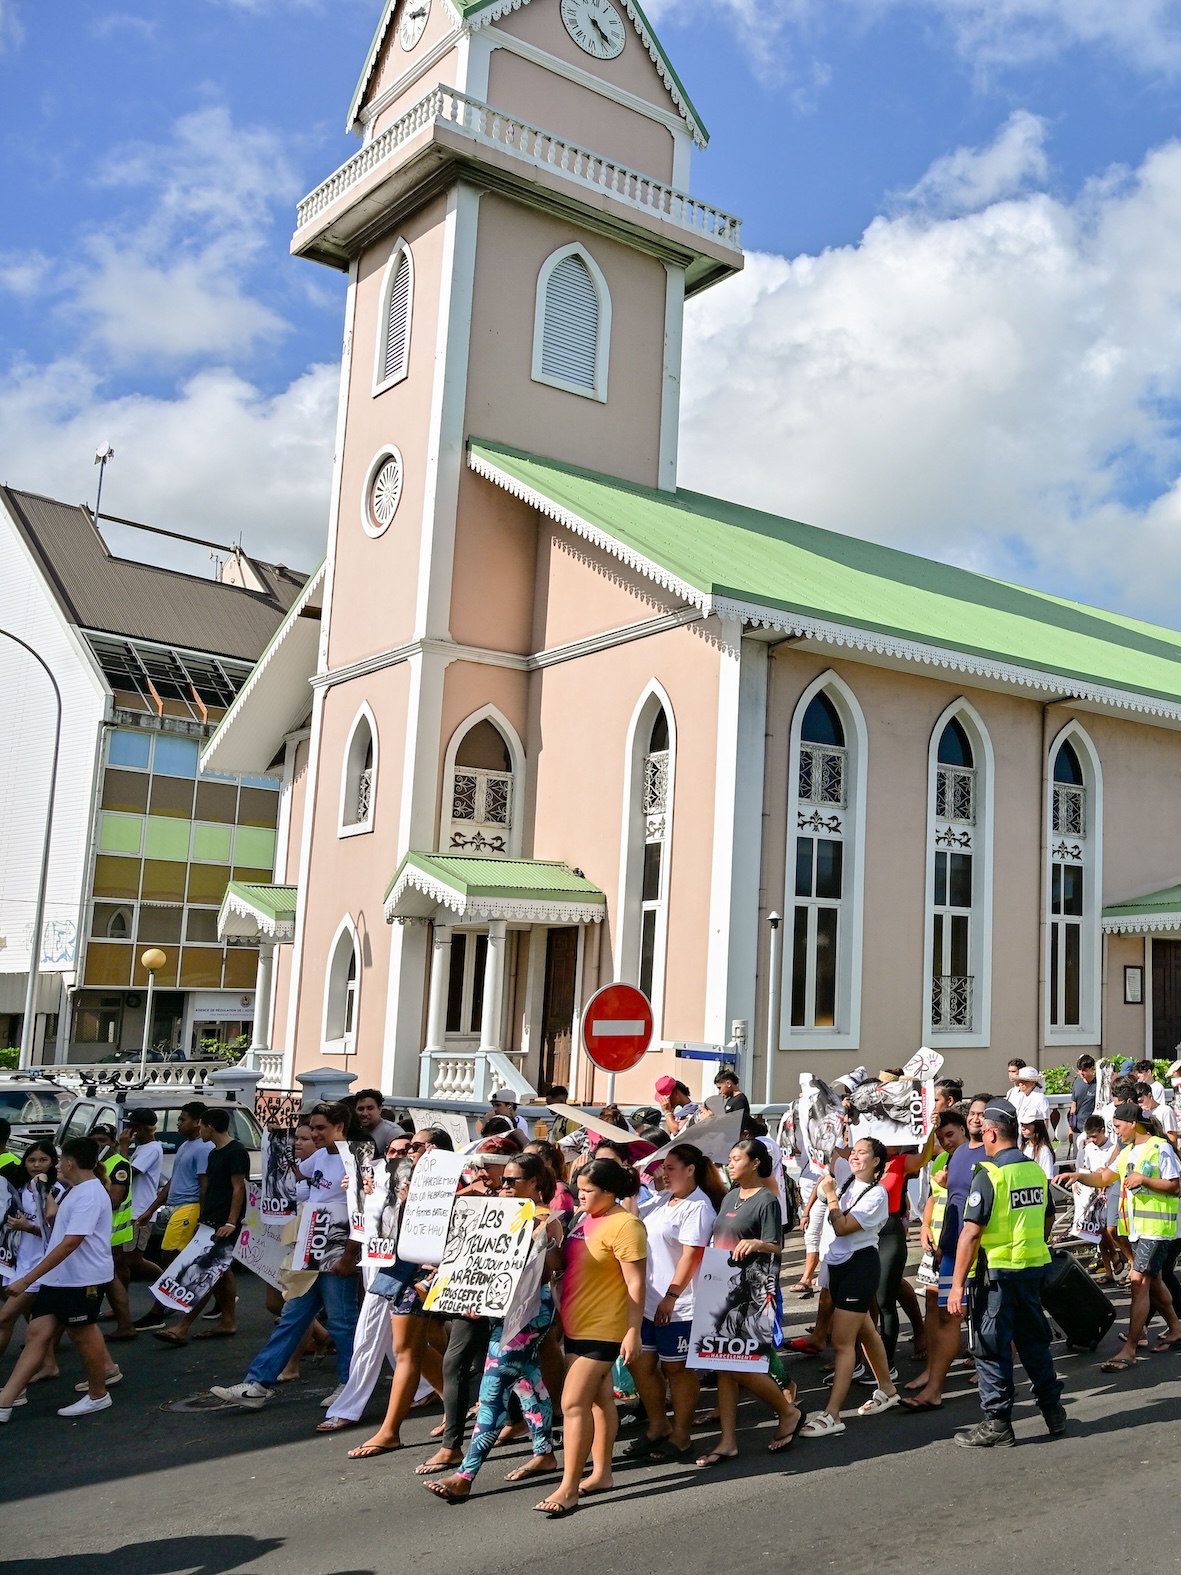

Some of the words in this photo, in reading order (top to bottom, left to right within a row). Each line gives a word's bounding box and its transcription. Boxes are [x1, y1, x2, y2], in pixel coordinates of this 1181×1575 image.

[910, 1090, 924, 1135] STOP
[780, 1147, 792, 1157] OP
[262, 1197, 288, 1212] STOP
[1012, 1187, 1045, 1206] POLICE
[353, 1212, 365, 1227] STO
[1077, 1219, 1100, 1233] STOP
[310, 1213, 331, 1261] STOP
[463, 1233, 512, 1257] JEUNES
[0, 1246, 13, 1262] OP
[161, 1277, 195, 1304] STOP
[458, 1288, 484, 1303] CETTE
[676, 1335, 689, 1354] LA
[701, 1335, 759, 1356] STOP
